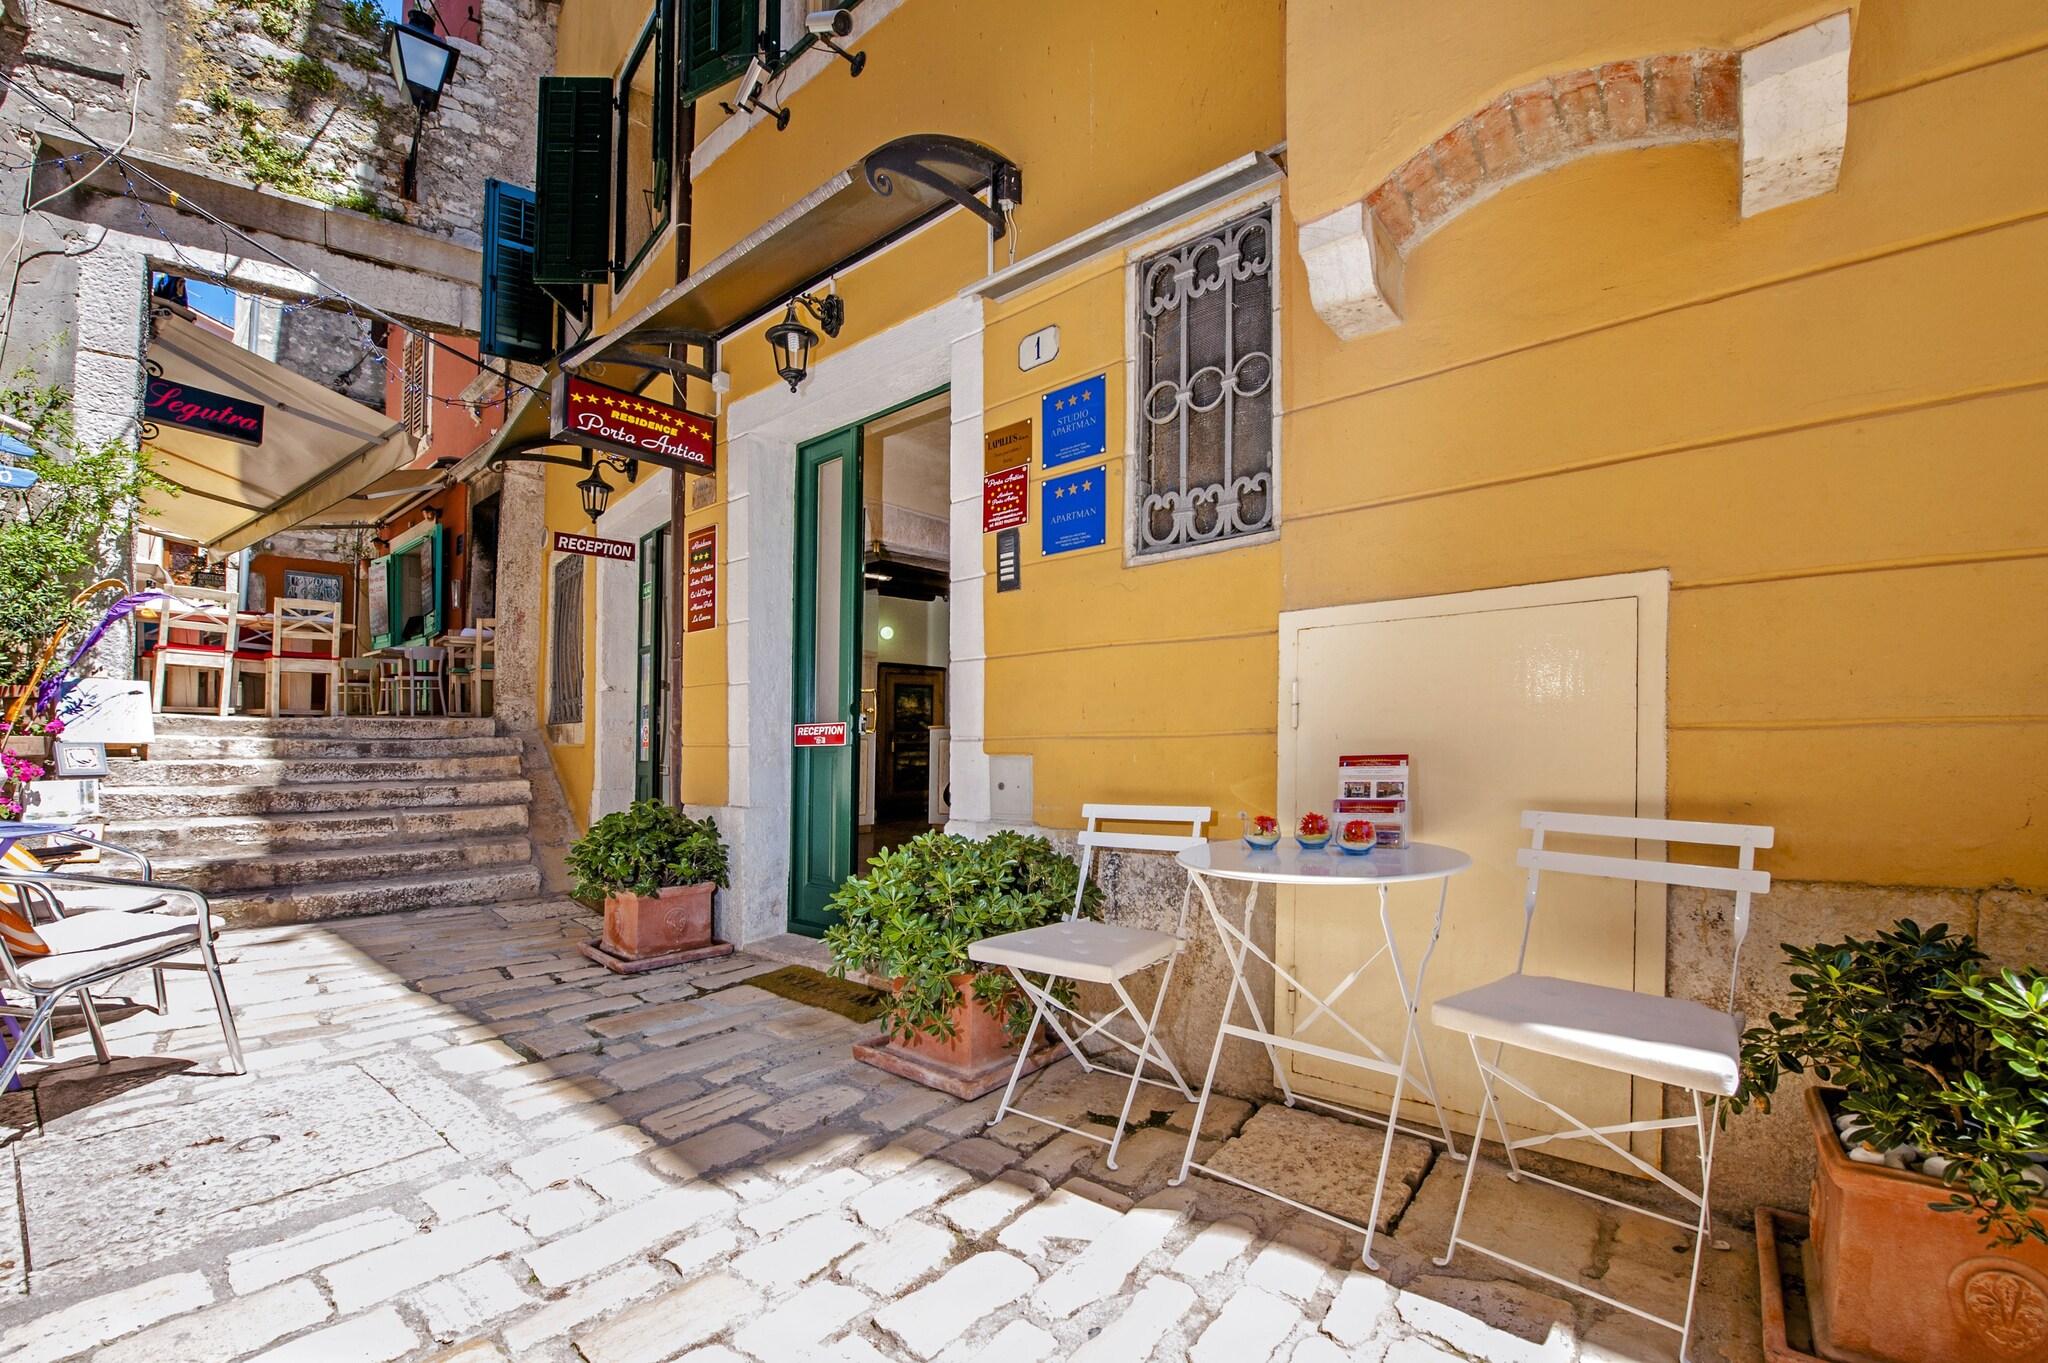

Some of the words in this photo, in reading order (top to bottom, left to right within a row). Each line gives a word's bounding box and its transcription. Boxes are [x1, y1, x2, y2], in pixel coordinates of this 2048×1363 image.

[1034, 336, 1041, 360] 1
[611, 410, 679, 437] RESIDENCE
[1051, 416, 1097, 439] APARTMAN
[1057, 408, 1089, 426] STUDIO
[577, 412, 637, 444] Porta
[641, 434, 705, 463] Antica
[1051, 505, 1097, 526] APARTMAN
[558, 535, 633, 558] RECEPTION
[797, 725, 844, 737] RECEPTION
